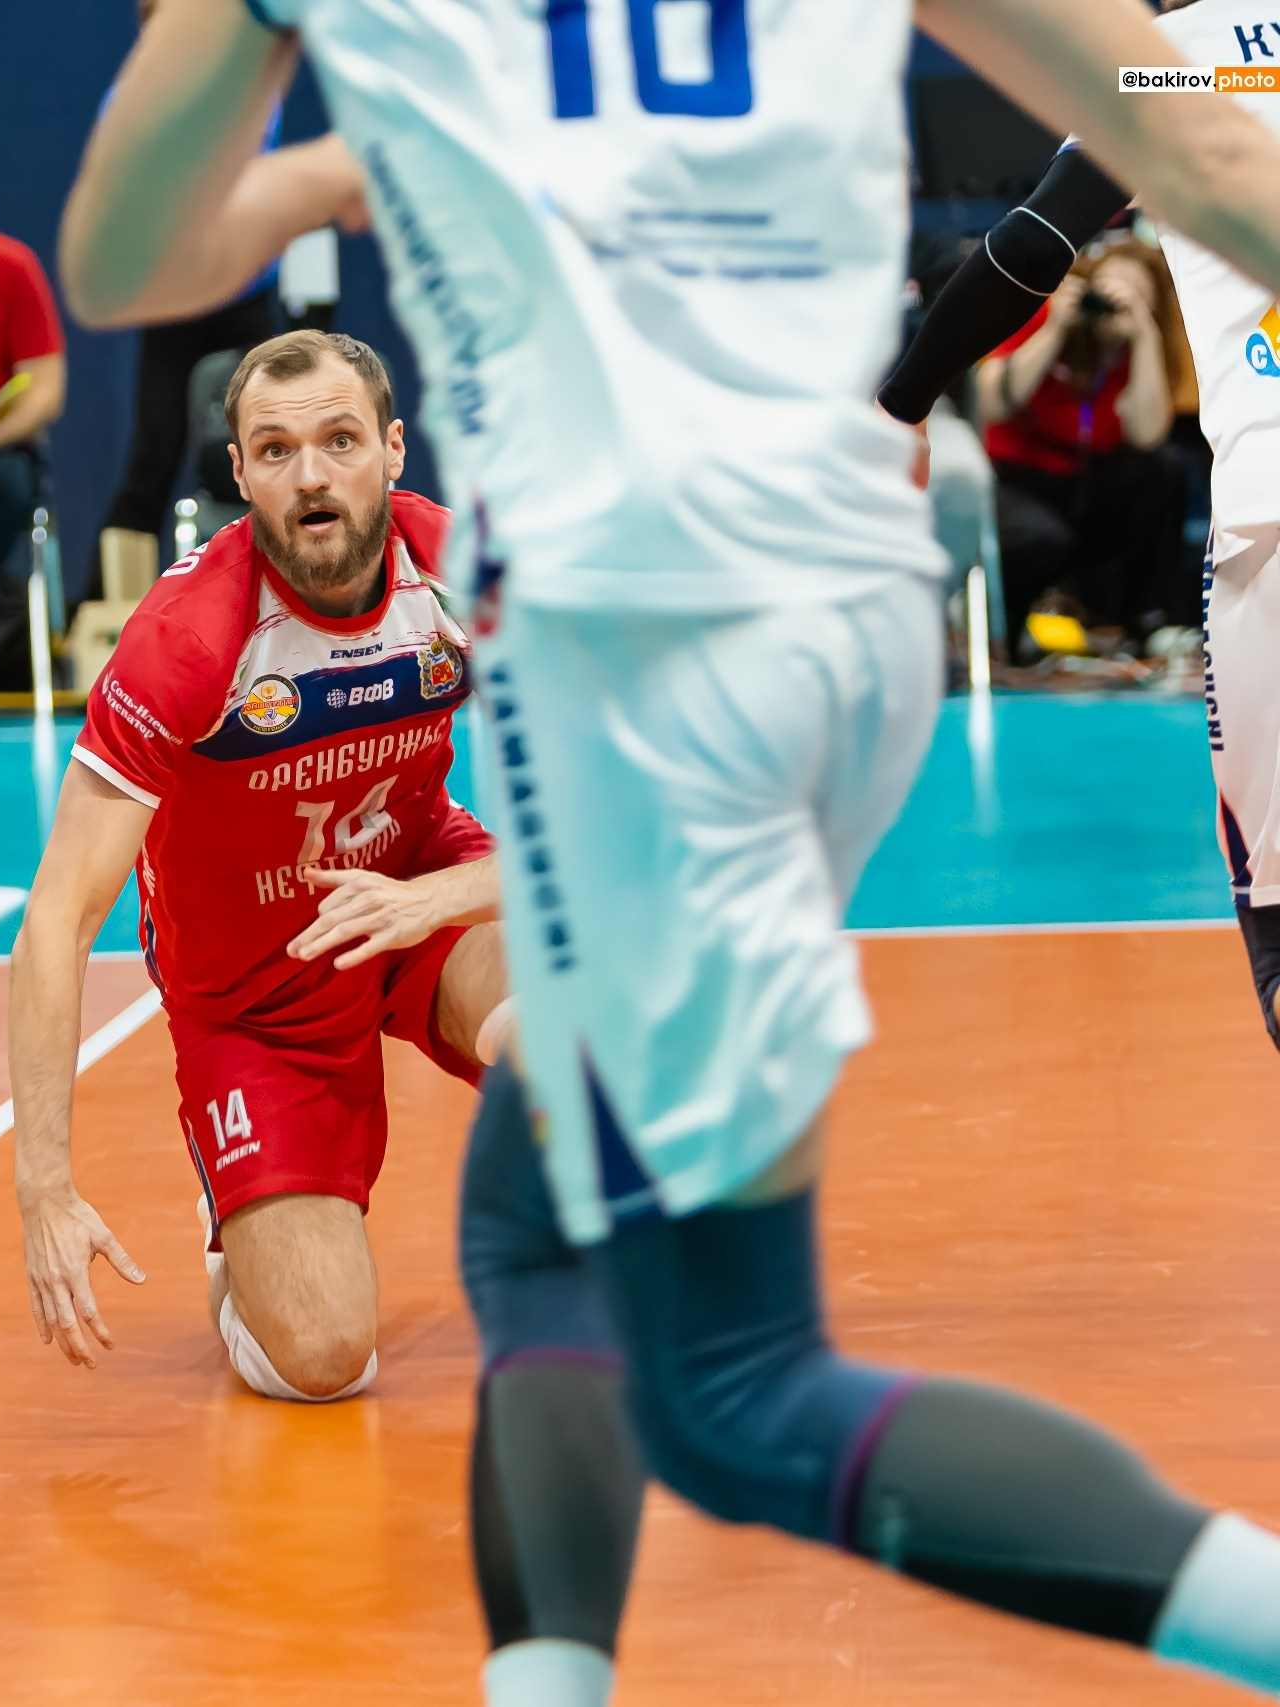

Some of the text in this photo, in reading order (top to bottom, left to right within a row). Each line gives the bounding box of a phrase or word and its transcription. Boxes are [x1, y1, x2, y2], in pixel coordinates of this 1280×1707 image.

[330, 642, 383, 659] ENSEN
[348, 678, 394, 706] ВФВ
[295, 774, 399, 864] 14
[206, 1088, 252, 1151] 14
